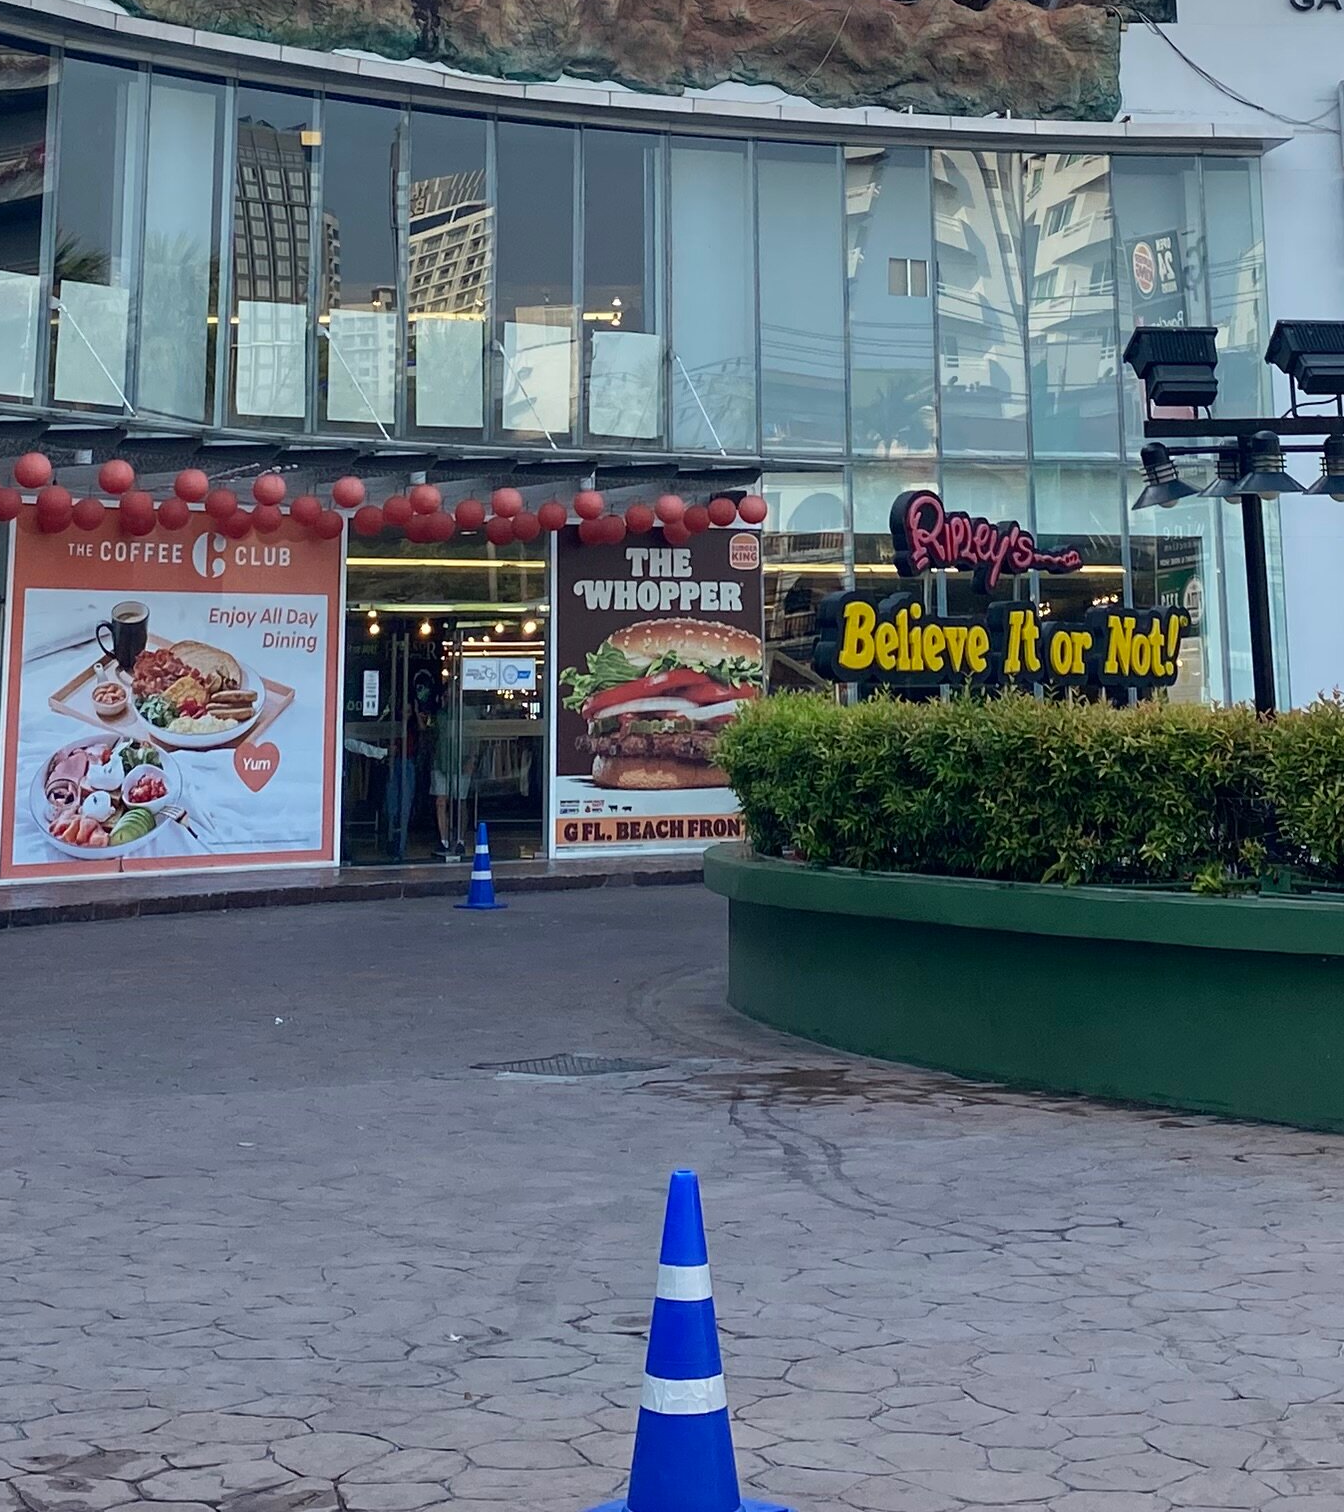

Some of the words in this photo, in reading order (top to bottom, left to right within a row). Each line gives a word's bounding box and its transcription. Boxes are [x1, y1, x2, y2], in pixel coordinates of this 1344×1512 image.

[68, 542, 93, 558] THE
[99, 540, 183, 564] COFFEE
[235, 546, 291, 567] CLUB
[625, 547, 692, 579] THE
[732, 551, 758, 562] KING
[573, 580, 743, 612] WHOPPER
[209, 606, 256, 628] Enjoy
[260, 607, 282, 624] All
[286, 609, 319, 628] Day
[262, 631, 317, 653] Dining
[838, 600, 991, 675] Believe
[1003, 607, 1042, 675] It
[1050, 629, 1093, 676] or
[1104, 612, 1180, 678] Not!
[243, 757, 271, 771] Yum
[564, 822, 578, 842] G
[582, 822, 612, 841] FL.
[616, 819, 684, 840] BEACH
[688, 817, 746, 838] FRON
